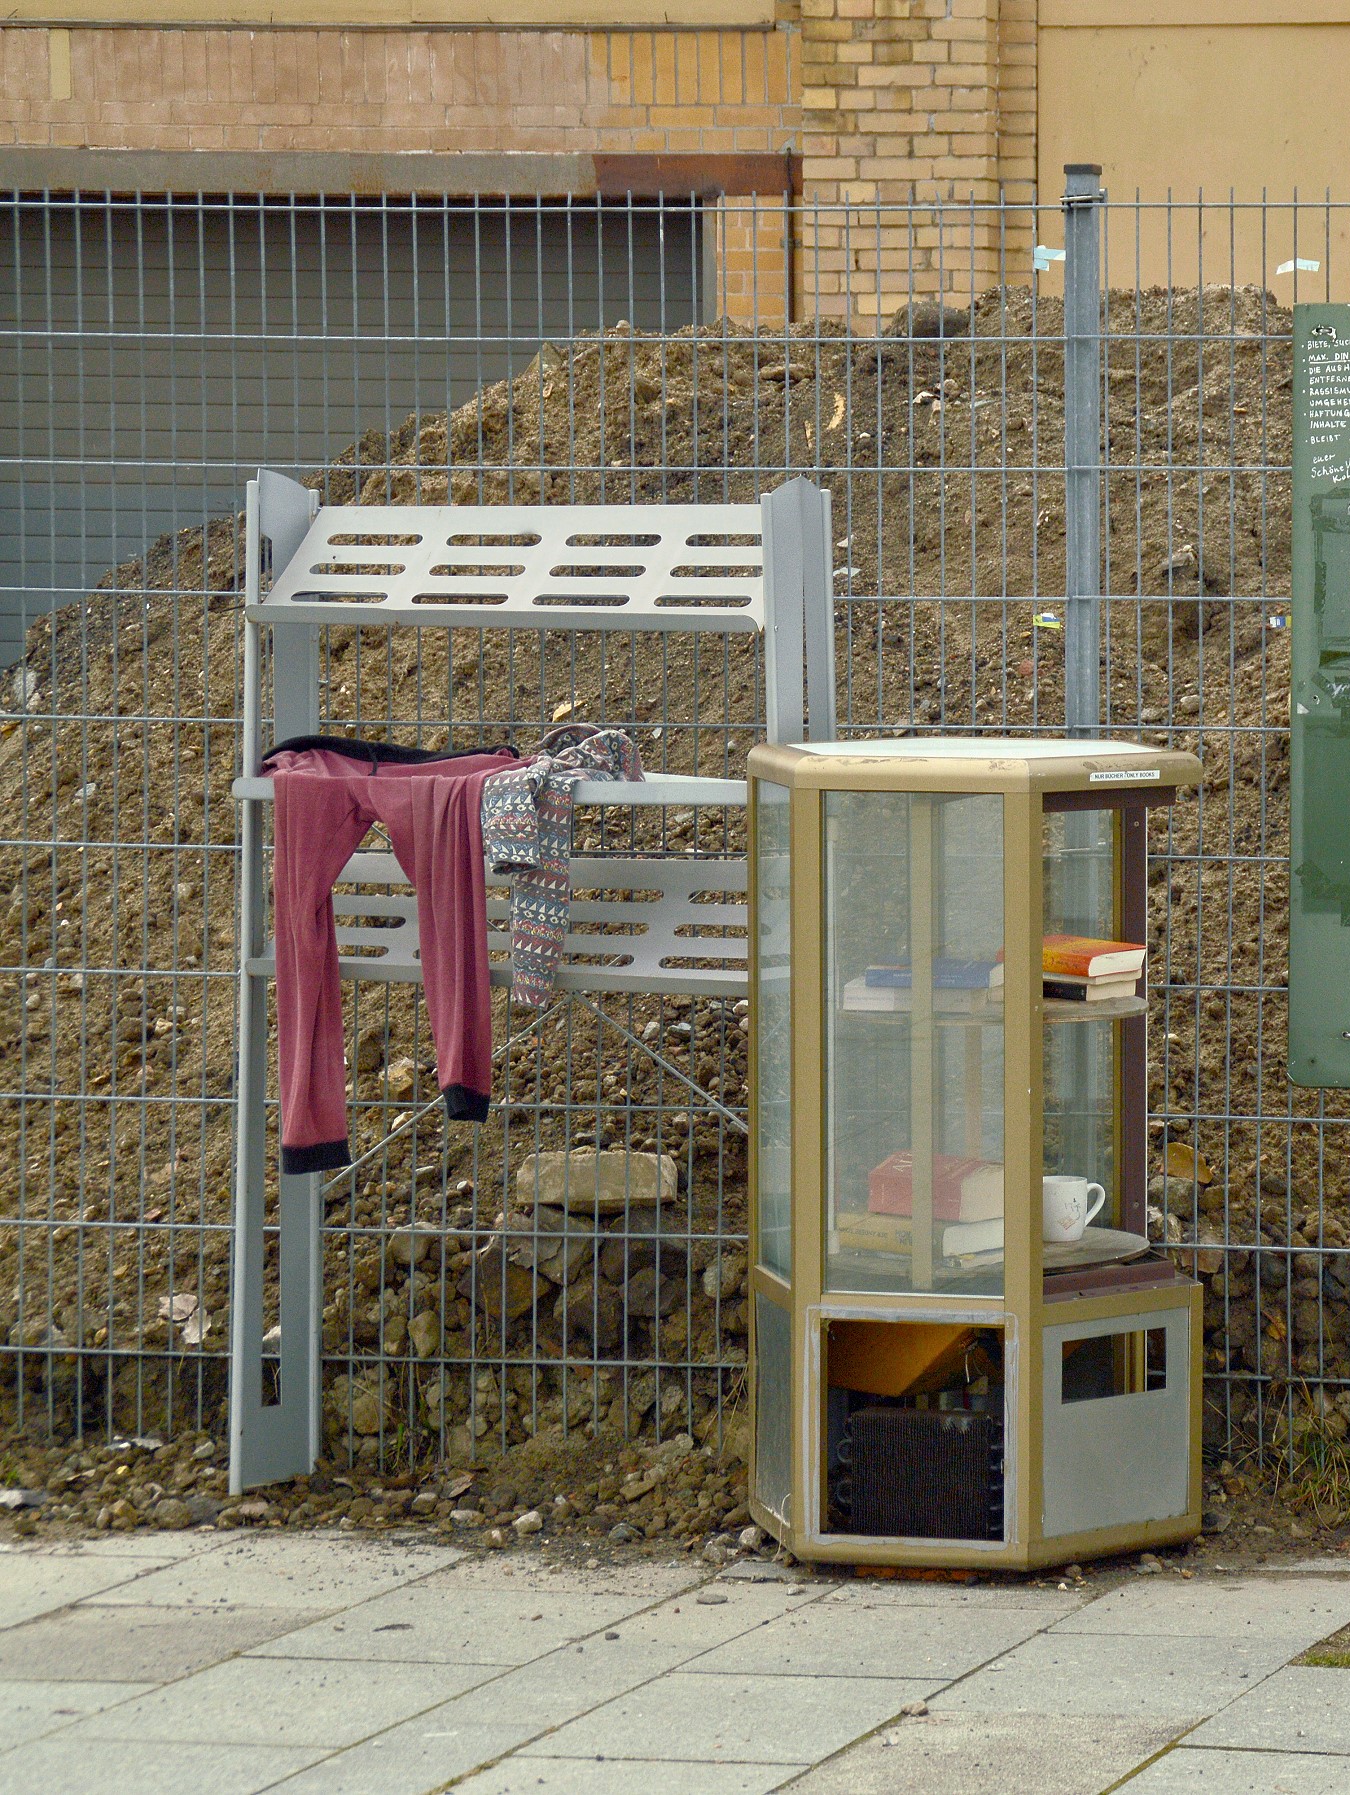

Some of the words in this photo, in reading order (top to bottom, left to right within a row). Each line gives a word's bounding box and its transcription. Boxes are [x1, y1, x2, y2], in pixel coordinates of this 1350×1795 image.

[1308, 340, 1330, 350] BIETE,
[1311, 434, 1340, 444] BLEIBT
[1313, 454, 1335, 463] euer
